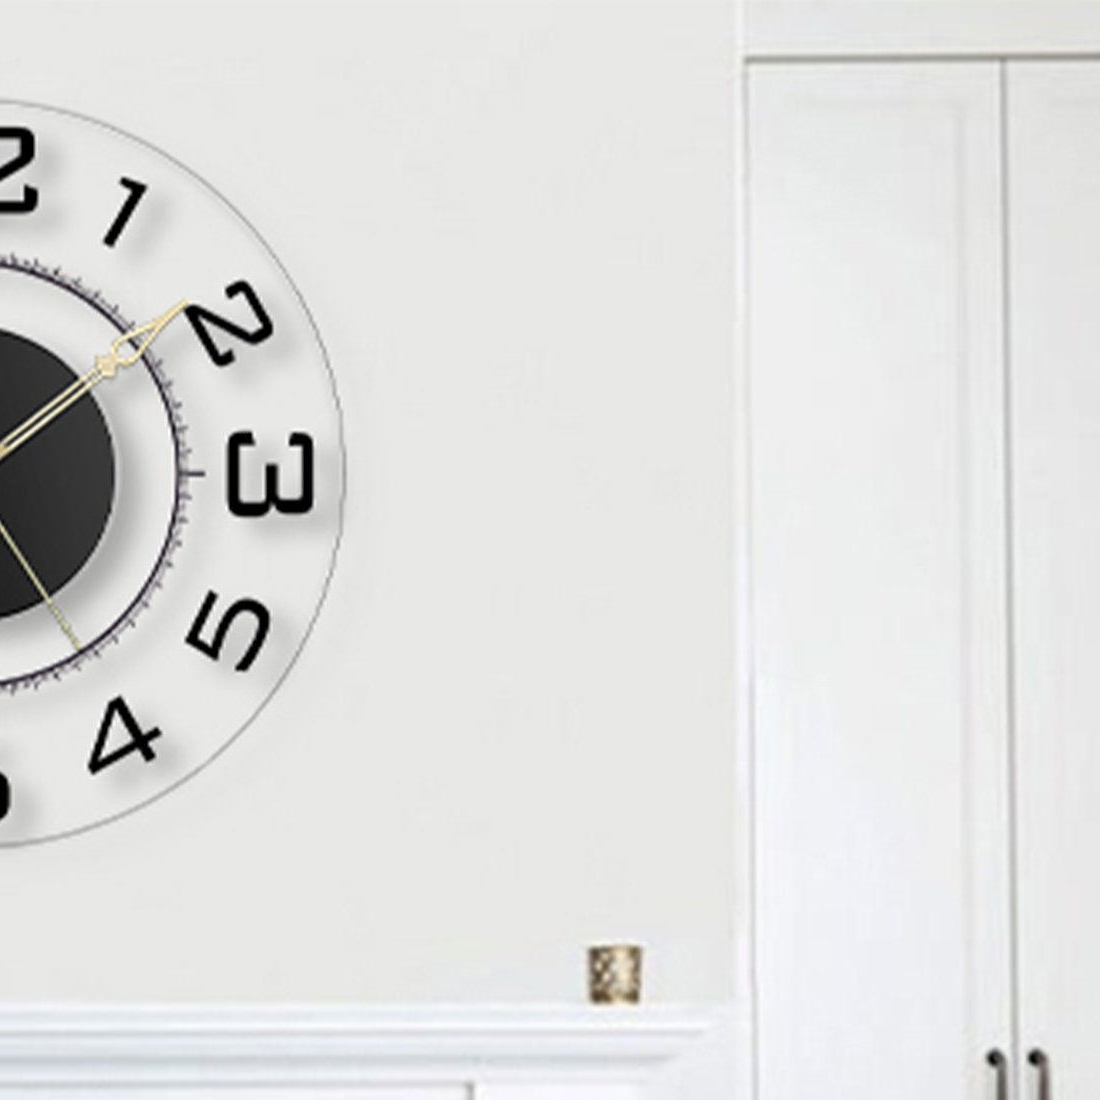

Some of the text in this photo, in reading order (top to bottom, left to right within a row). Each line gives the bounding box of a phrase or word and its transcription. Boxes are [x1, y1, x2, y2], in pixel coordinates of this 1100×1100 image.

[103, 177, 148, 247] 1
[183, 280, 274, 367] 2
[227, 431, 314, 518] 3
[185, 590, 271, 672] 5
[87, 696, 162, 775] 4
